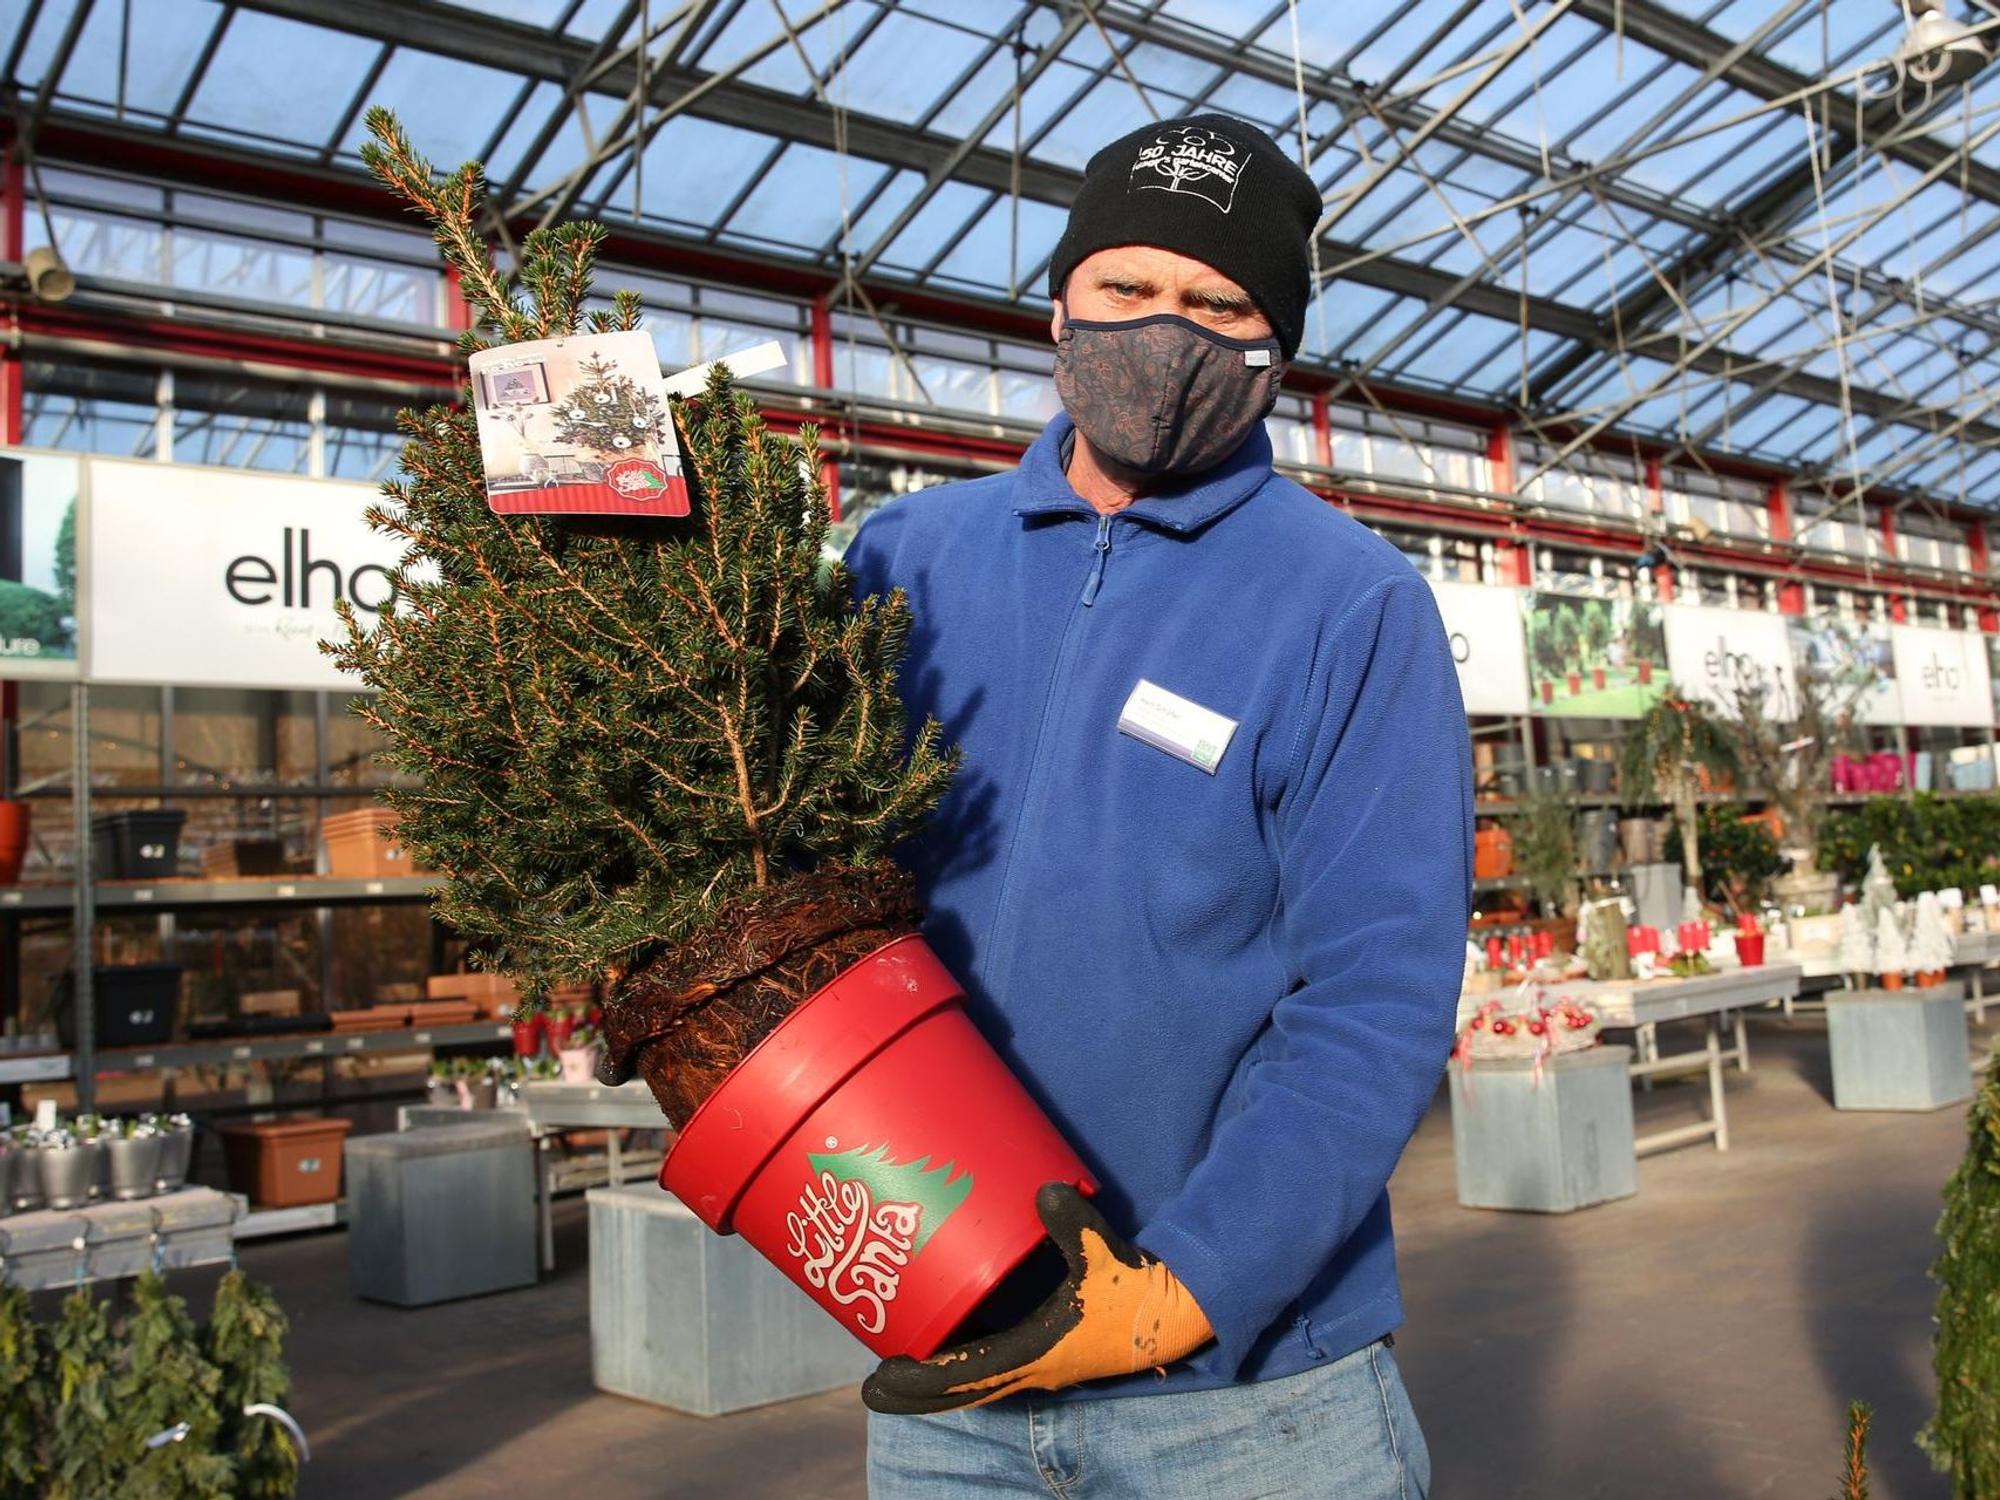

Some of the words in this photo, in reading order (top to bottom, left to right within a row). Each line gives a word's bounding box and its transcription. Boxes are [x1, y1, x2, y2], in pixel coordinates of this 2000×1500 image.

[1140, 146, 1165, 160] 50
[1171, 144, 1239, 176] JAHRE
[226, 527, 398, 613] elho
[787, 1171, 868, 1288] Little
[828, 1203, 922, 1335] Santa
